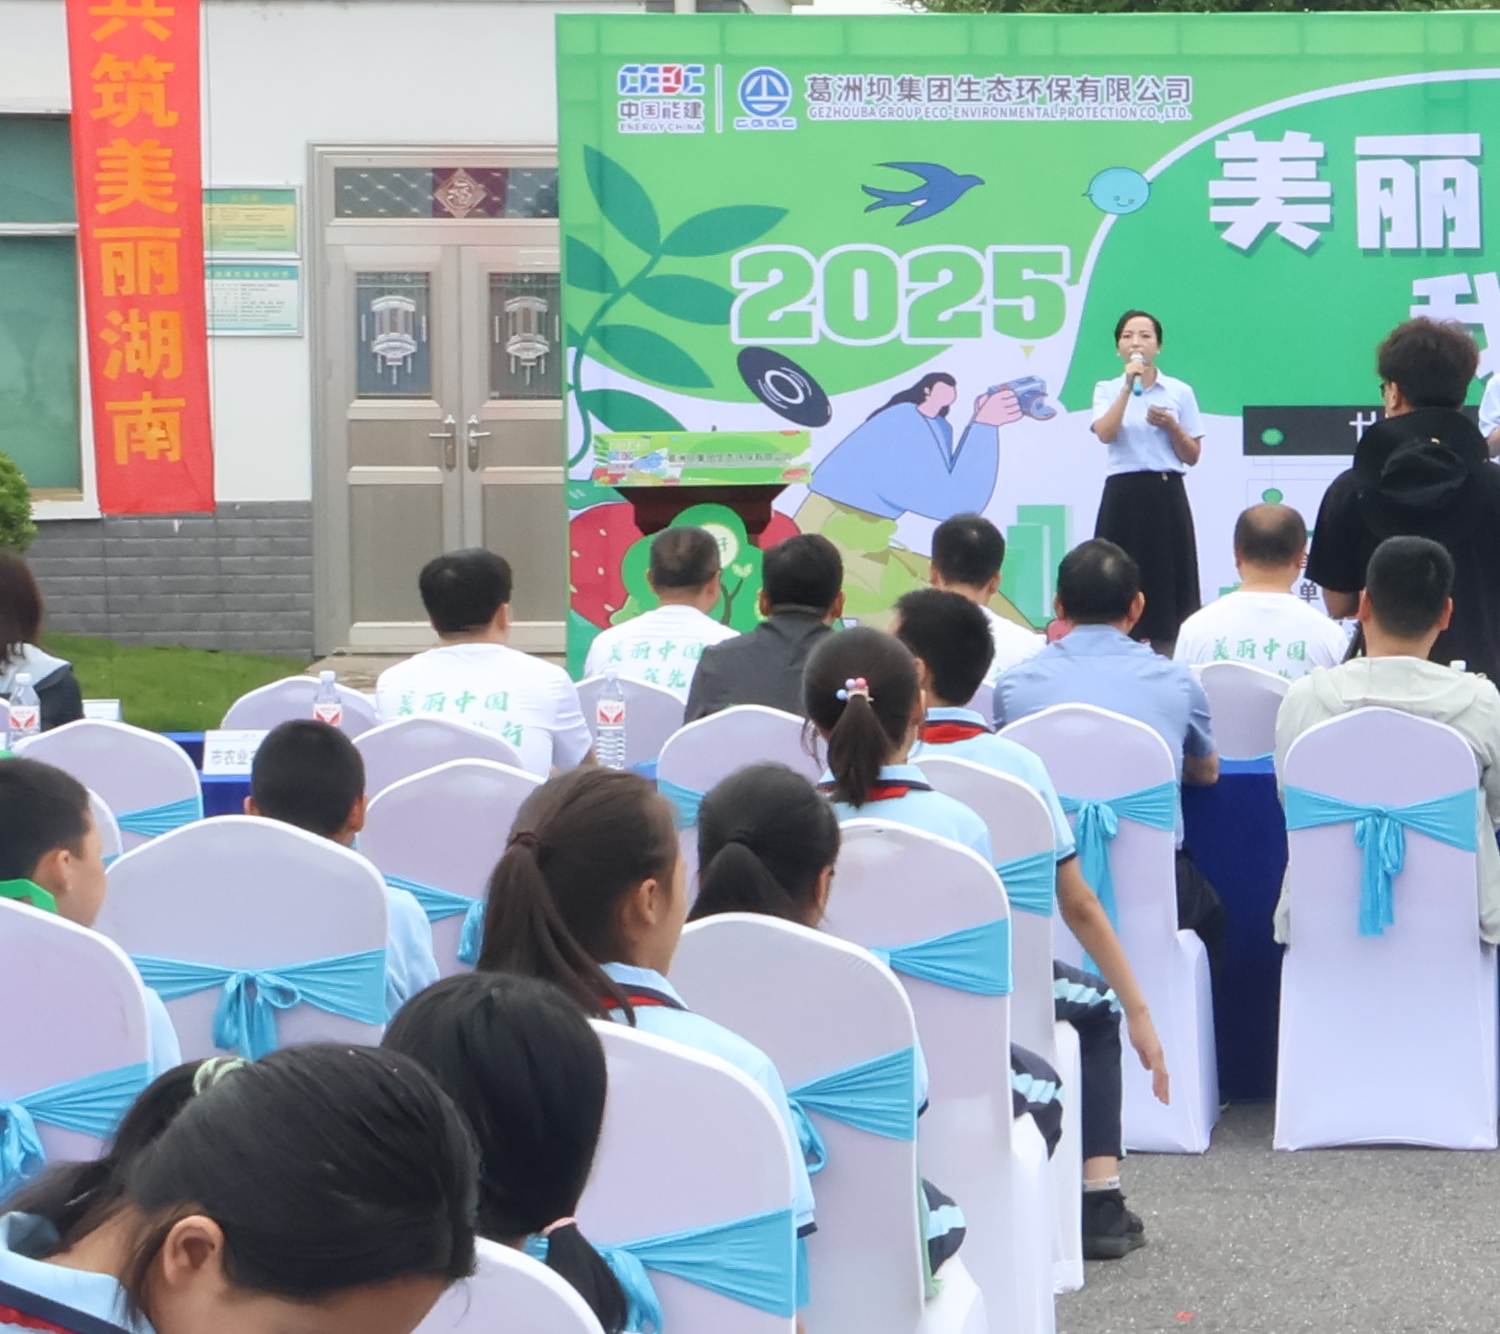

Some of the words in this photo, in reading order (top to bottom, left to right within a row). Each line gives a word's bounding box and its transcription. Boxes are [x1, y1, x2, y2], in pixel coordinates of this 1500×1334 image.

[806, 76, 1191, 103] 葛洲坝集团生态环保有限公司
[619, 101, 702, 120] 中国能建
[809, 107, 877, 119] GEZHOUBA
[879, 107, 921, 119] GROUP
[1060, 106, 1137, 119] PROTECTION
[619, 123, 664, 132] ENERGY
[669, 123, 702, 132] CHINA
[730, 243, 1072, 346] 2025
[1213, 636, 1306, 662] 美丽中国
[398, 690, 510, 717] 美丽中国
